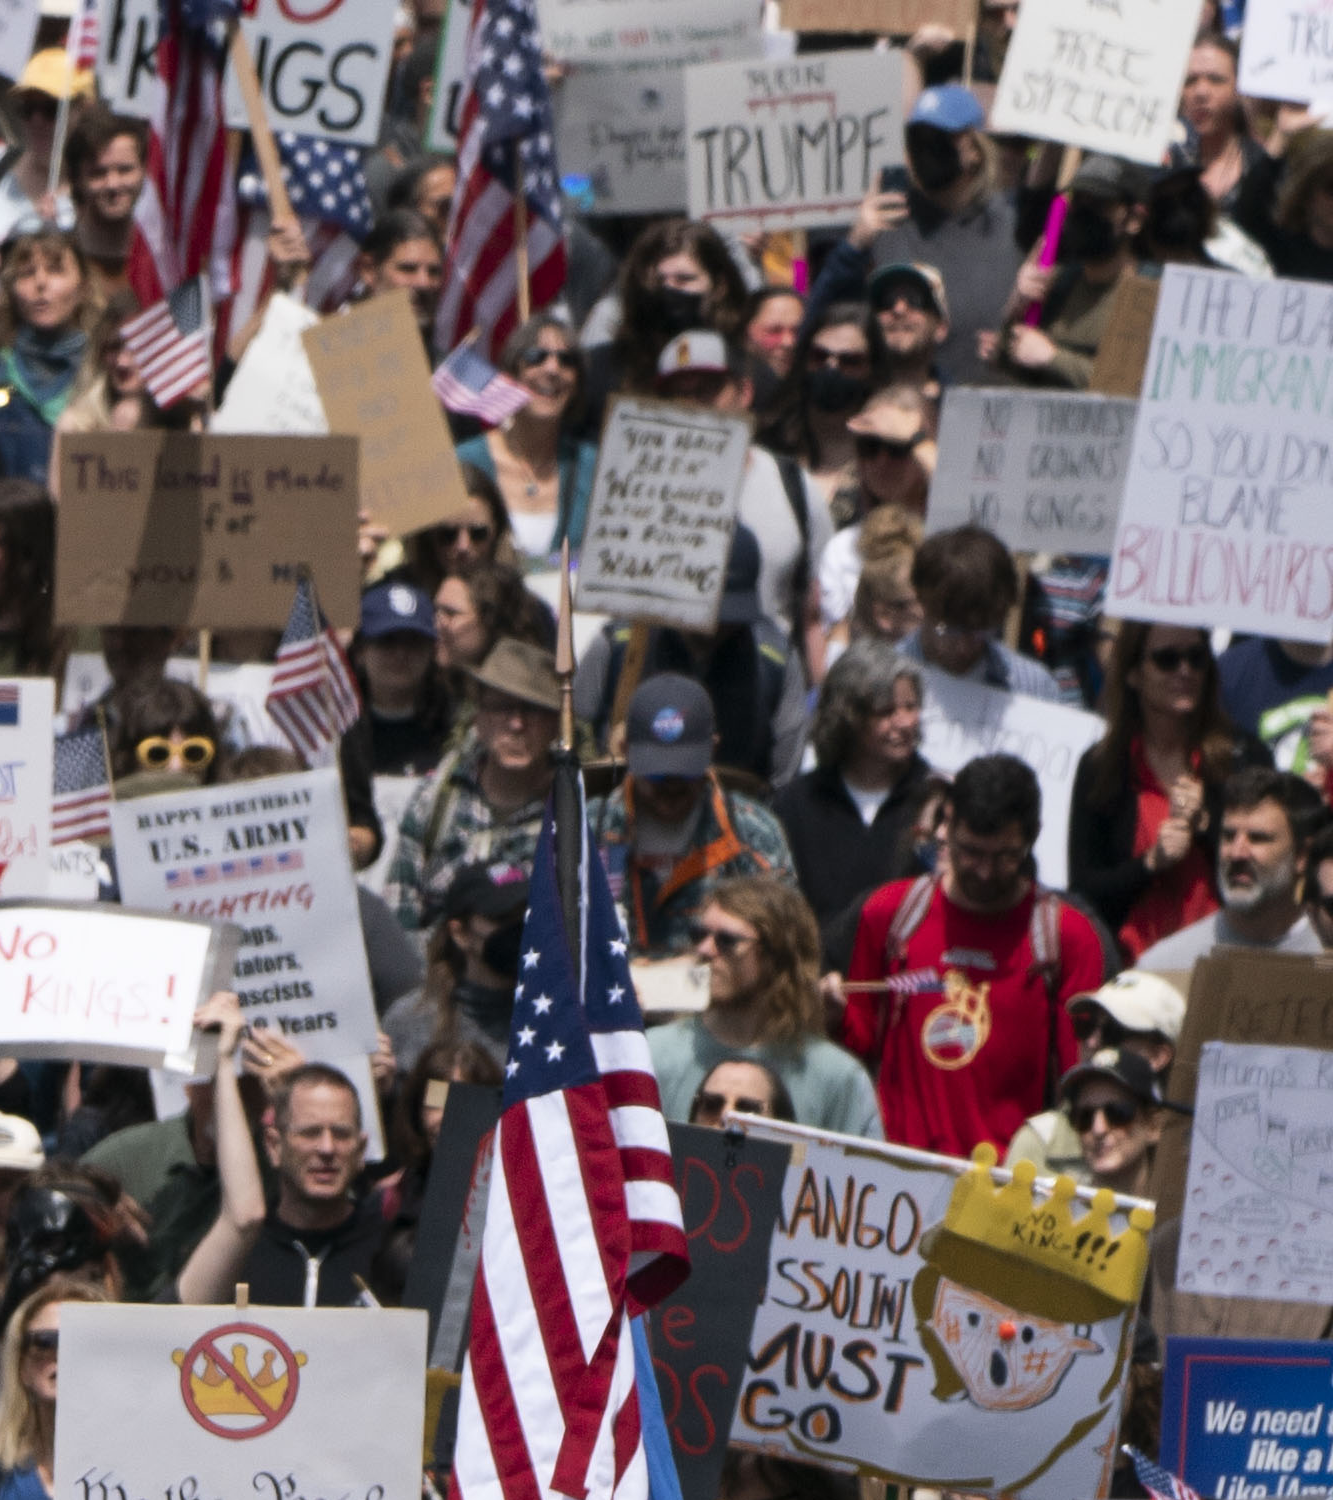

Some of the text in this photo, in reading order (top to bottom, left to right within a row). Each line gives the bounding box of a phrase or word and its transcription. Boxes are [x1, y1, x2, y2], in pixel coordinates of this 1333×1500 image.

[695, 107, 889, 205] TRUMPF
[1181, 478, 1290, 535] BLAME
[136, 789, 315, 831] HAPPY BIRTHDAY
[149, 815, 312, 864] U.S. ARMY
[22, 973, 178, 1027] KINGS!
[1027, 1205, 1059, 1228] NO
[1205, 1400, 1321, 1436] We need
[1246, 1440, 1321, 1473] like a
